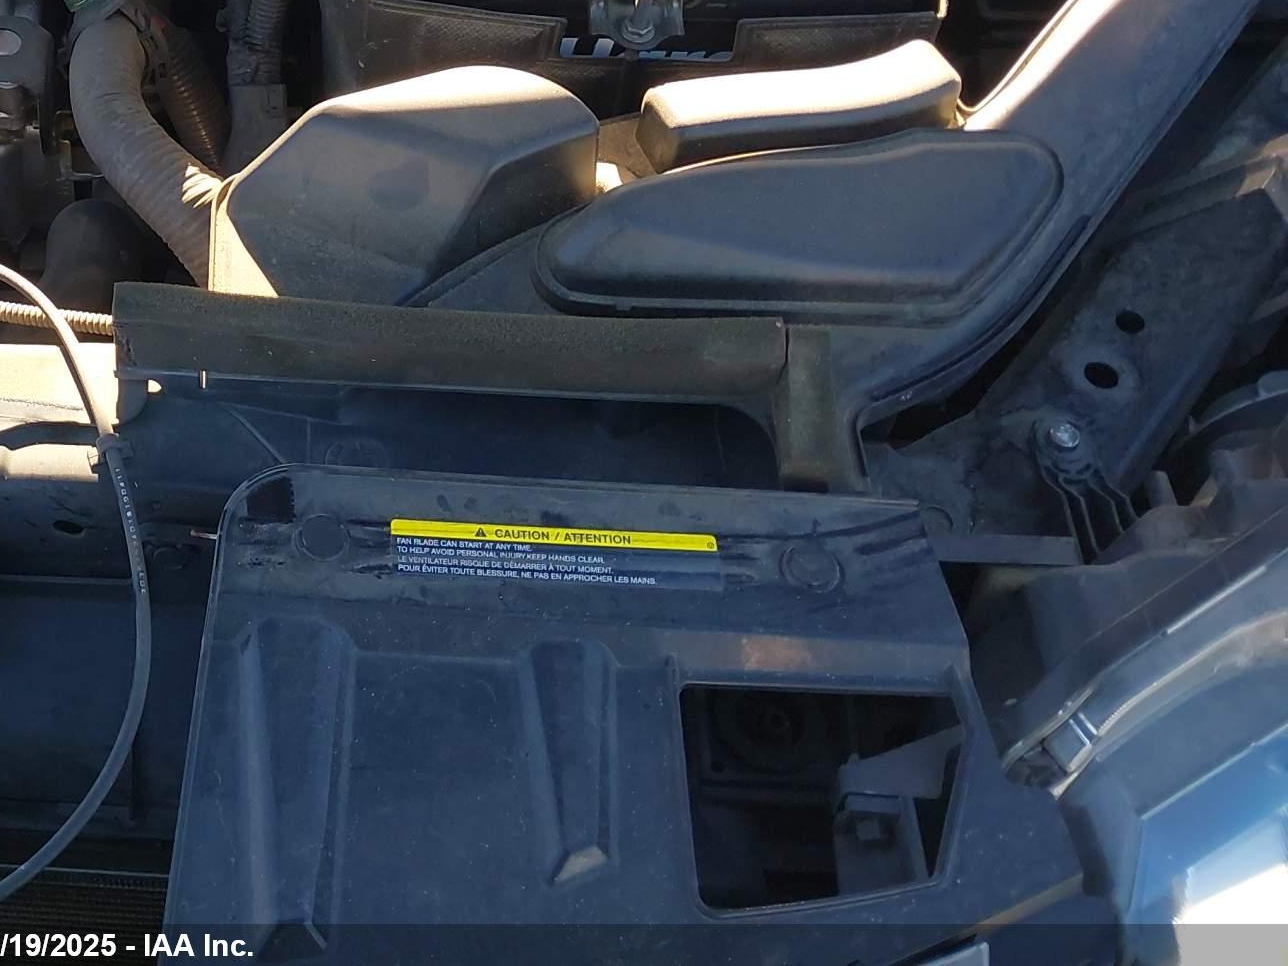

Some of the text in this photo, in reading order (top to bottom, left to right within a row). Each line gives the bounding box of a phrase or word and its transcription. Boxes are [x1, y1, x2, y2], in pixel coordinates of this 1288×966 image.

[397, 537, 412, 545] FAN
[495, 529, 631, 544] CAUTION / ATTENTION
[431, 547, 454, 555] AVOID
[457, 549, 498, 558] PERSONAL
[527, 553, 547, 561] KEEP
[548, 554, 576, 562] HANDS
[409, 556, 458, 565] VENTILATEUR
[460, 559, 490, 567] RISQUE
[504, 561, 547, 571] DÉMARRER
[548, 562, 554, 570] À
[555, 564, 576, 572] TOUT
[578, 566, 613, 574] MOMENT.
[398, 564, 420, 572] POUR
[422, 563, 448, 573] ÉVITER
[450, 567, 475, 575] TOUTE
[563, 574, 612, 583] APPROCHER
